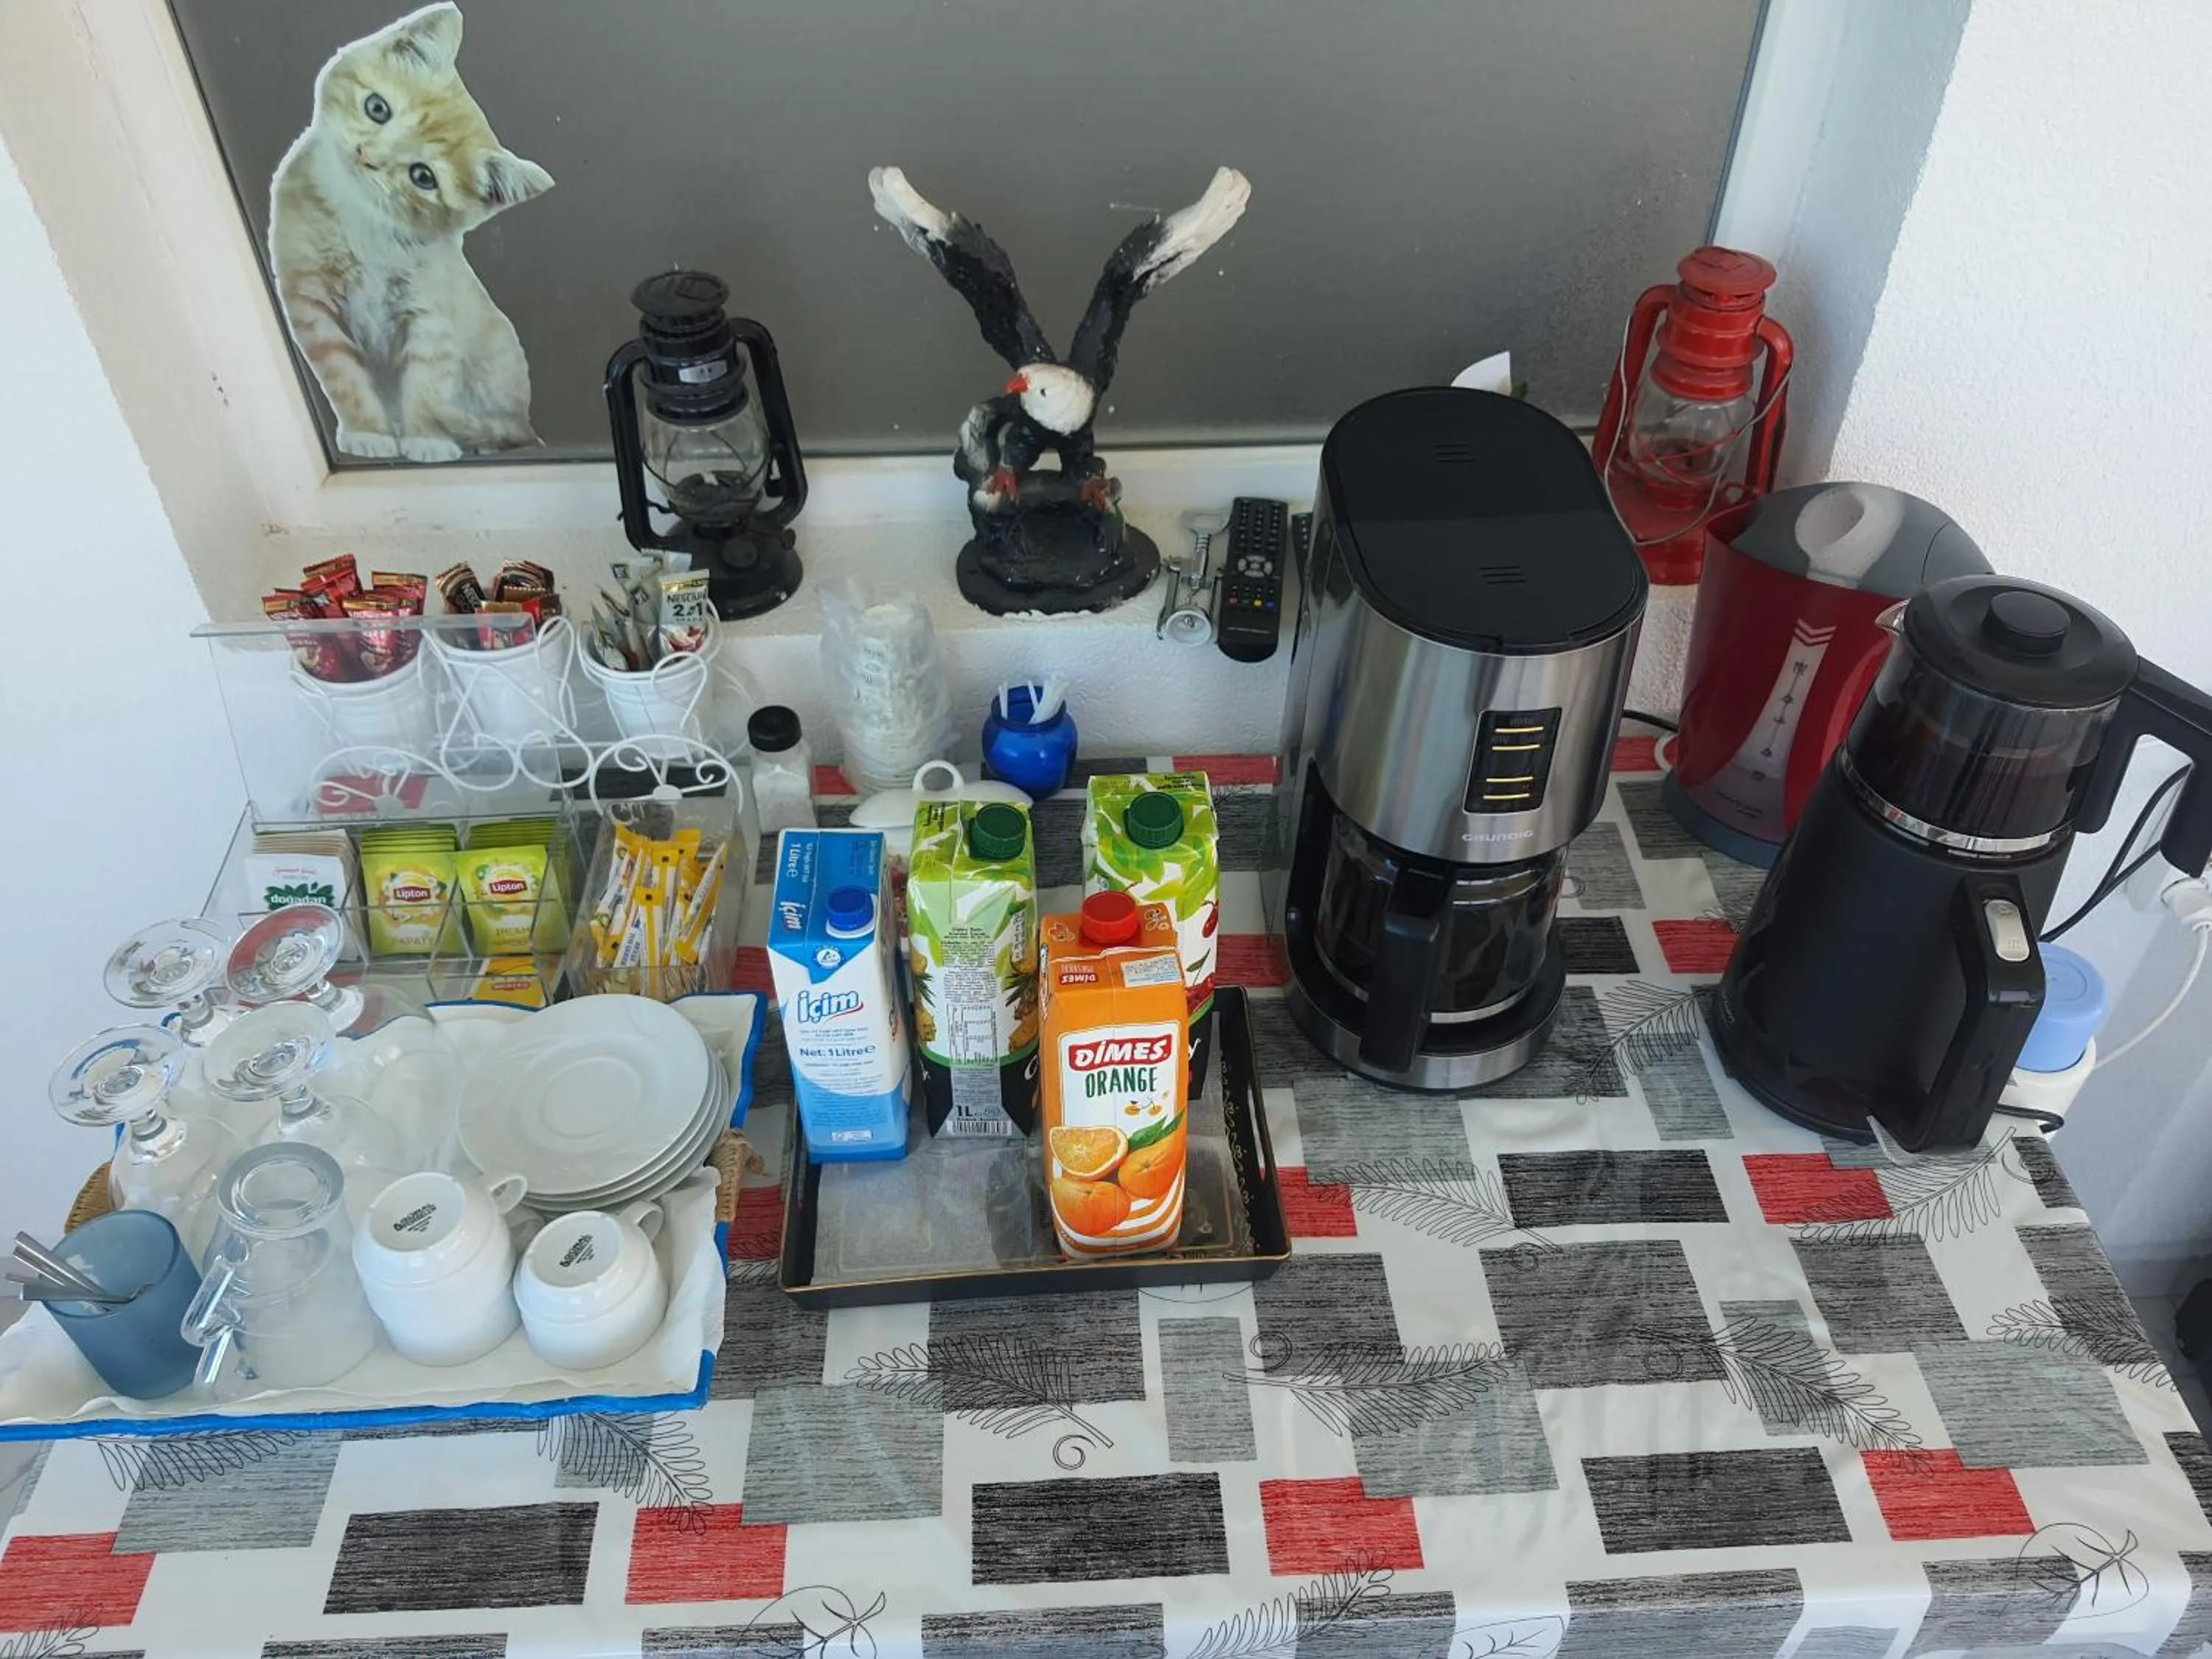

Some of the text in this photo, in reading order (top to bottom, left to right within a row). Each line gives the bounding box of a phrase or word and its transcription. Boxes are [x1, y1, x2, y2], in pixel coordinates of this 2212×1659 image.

[492, 881, 525, 893] Lipton
[396, 888, 428, 900] Lipton
[1085, 1066, 1157, 1098] ORANGE
